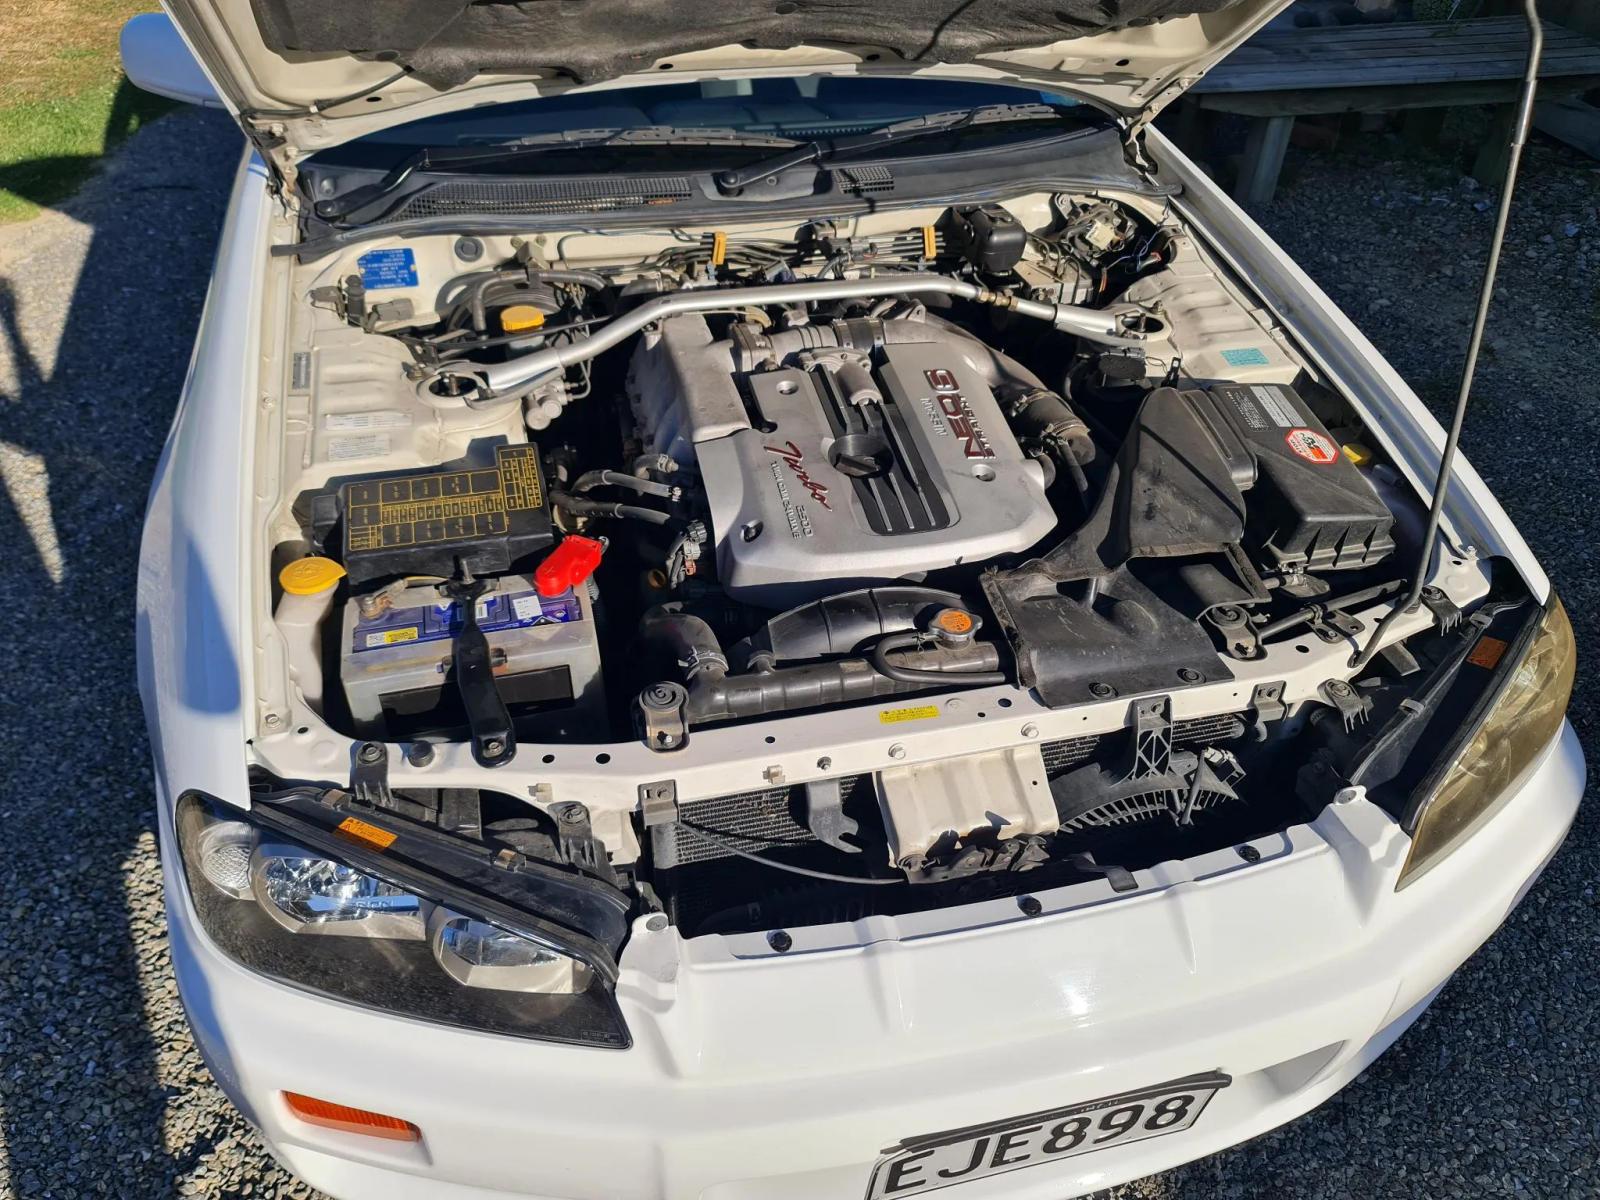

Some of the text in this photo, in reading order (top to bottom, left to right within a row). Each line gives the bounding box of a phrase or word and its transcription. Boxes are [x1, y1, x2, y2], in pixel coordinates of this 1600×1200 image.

[919, 396, 949, 438] NISSAN
[763, 440, 833, 512] Turbo
[795, 503, 814, 538] 2500
[885, 1094, 1195, 1193] EJE898
